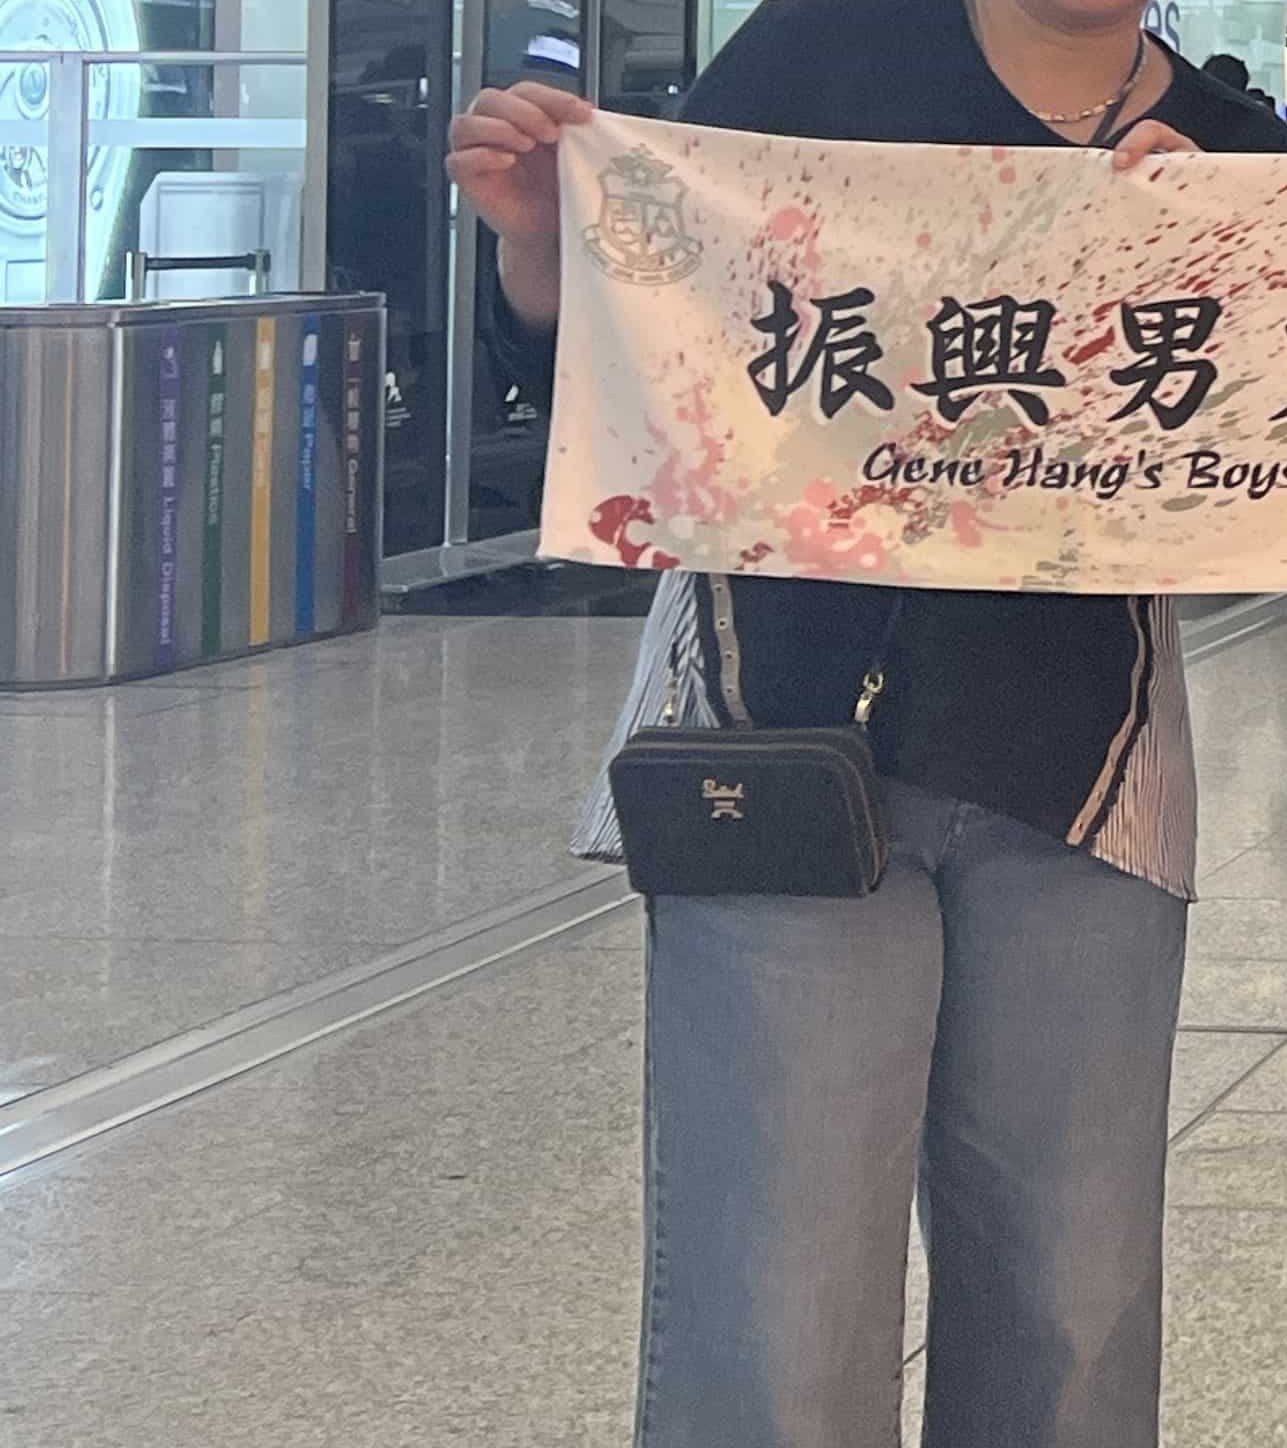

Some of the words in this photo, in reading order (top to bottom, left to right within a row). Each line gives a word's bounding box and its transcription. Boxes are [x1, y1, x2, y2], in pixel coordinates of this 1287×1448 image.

[299, 433, 314, 489] Paper
[863, 442, 985, 490] Gene
[1005, 448, 1162, 499] Hang's
[345, 458, 359, 533] General
[160, 497, 174, 554] Liquid
[159, 562, 173, 645] Disposal
